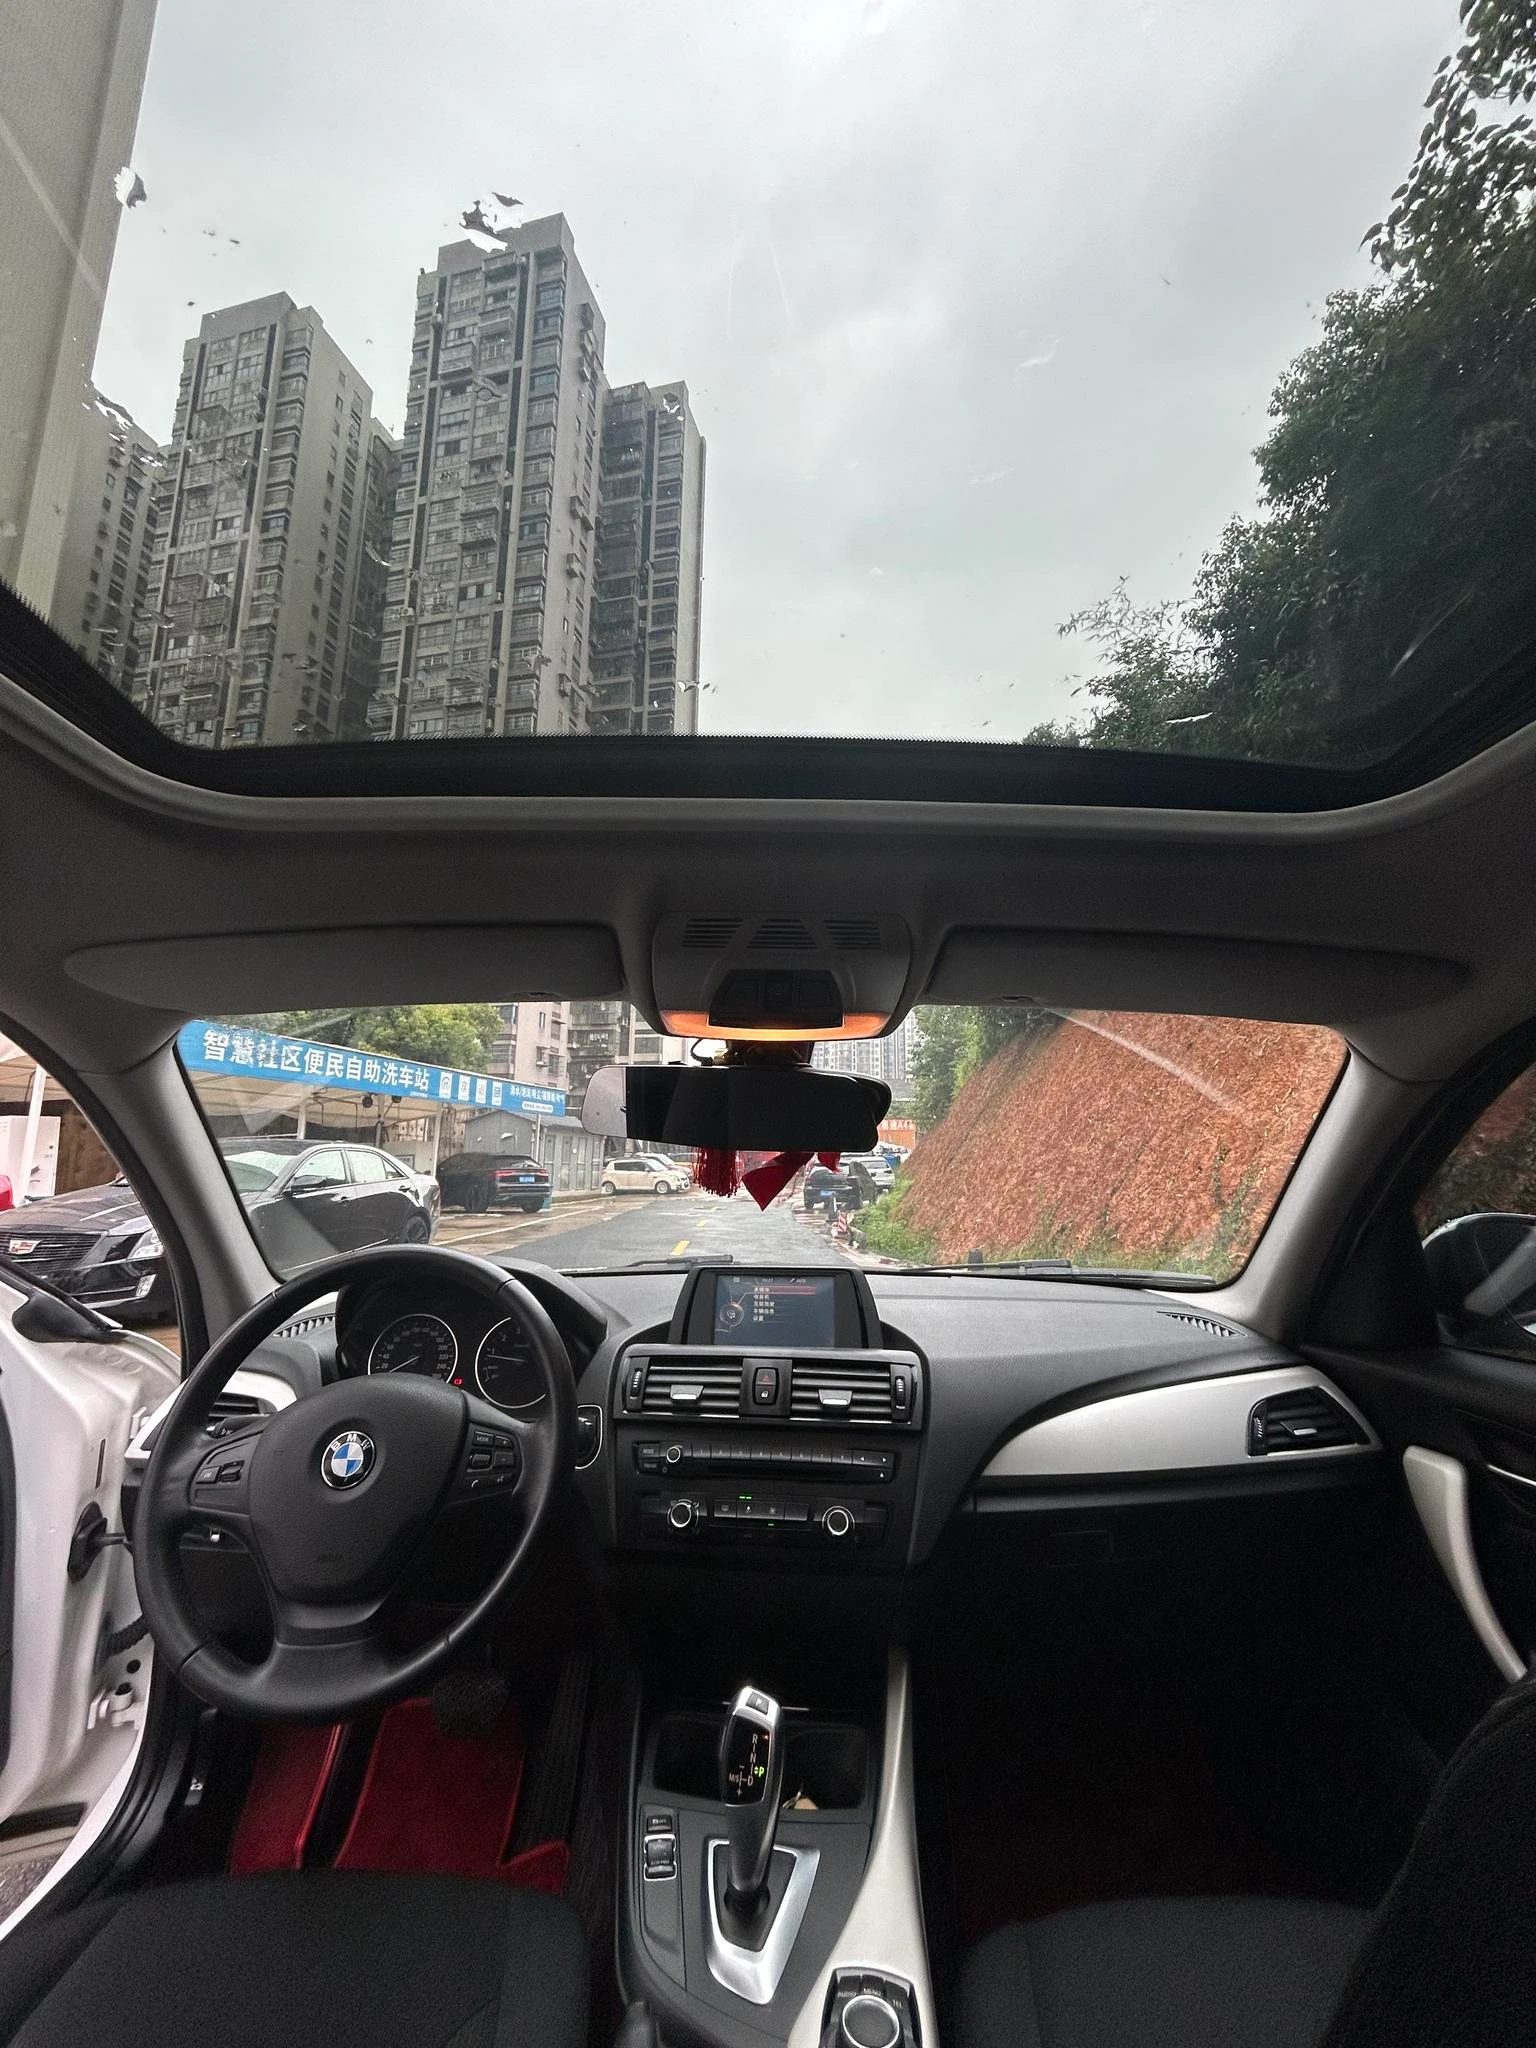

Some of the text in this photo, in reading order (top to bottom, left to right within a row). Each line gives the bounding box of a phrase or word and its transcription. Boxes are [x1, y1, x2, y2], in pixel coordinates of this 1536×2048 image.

[203, 1029, 430, 1092] 智慧社区便民自助洗车站
[330, 1433, 371, 1451] BMW
[755, 1698, 762, 1706] P
[751, 1733, 758, 1744] R
[749, 1752, 757, 1763] N
[758, 1766, 765, 1777] P
[747, 1775, 754, 1786] D
